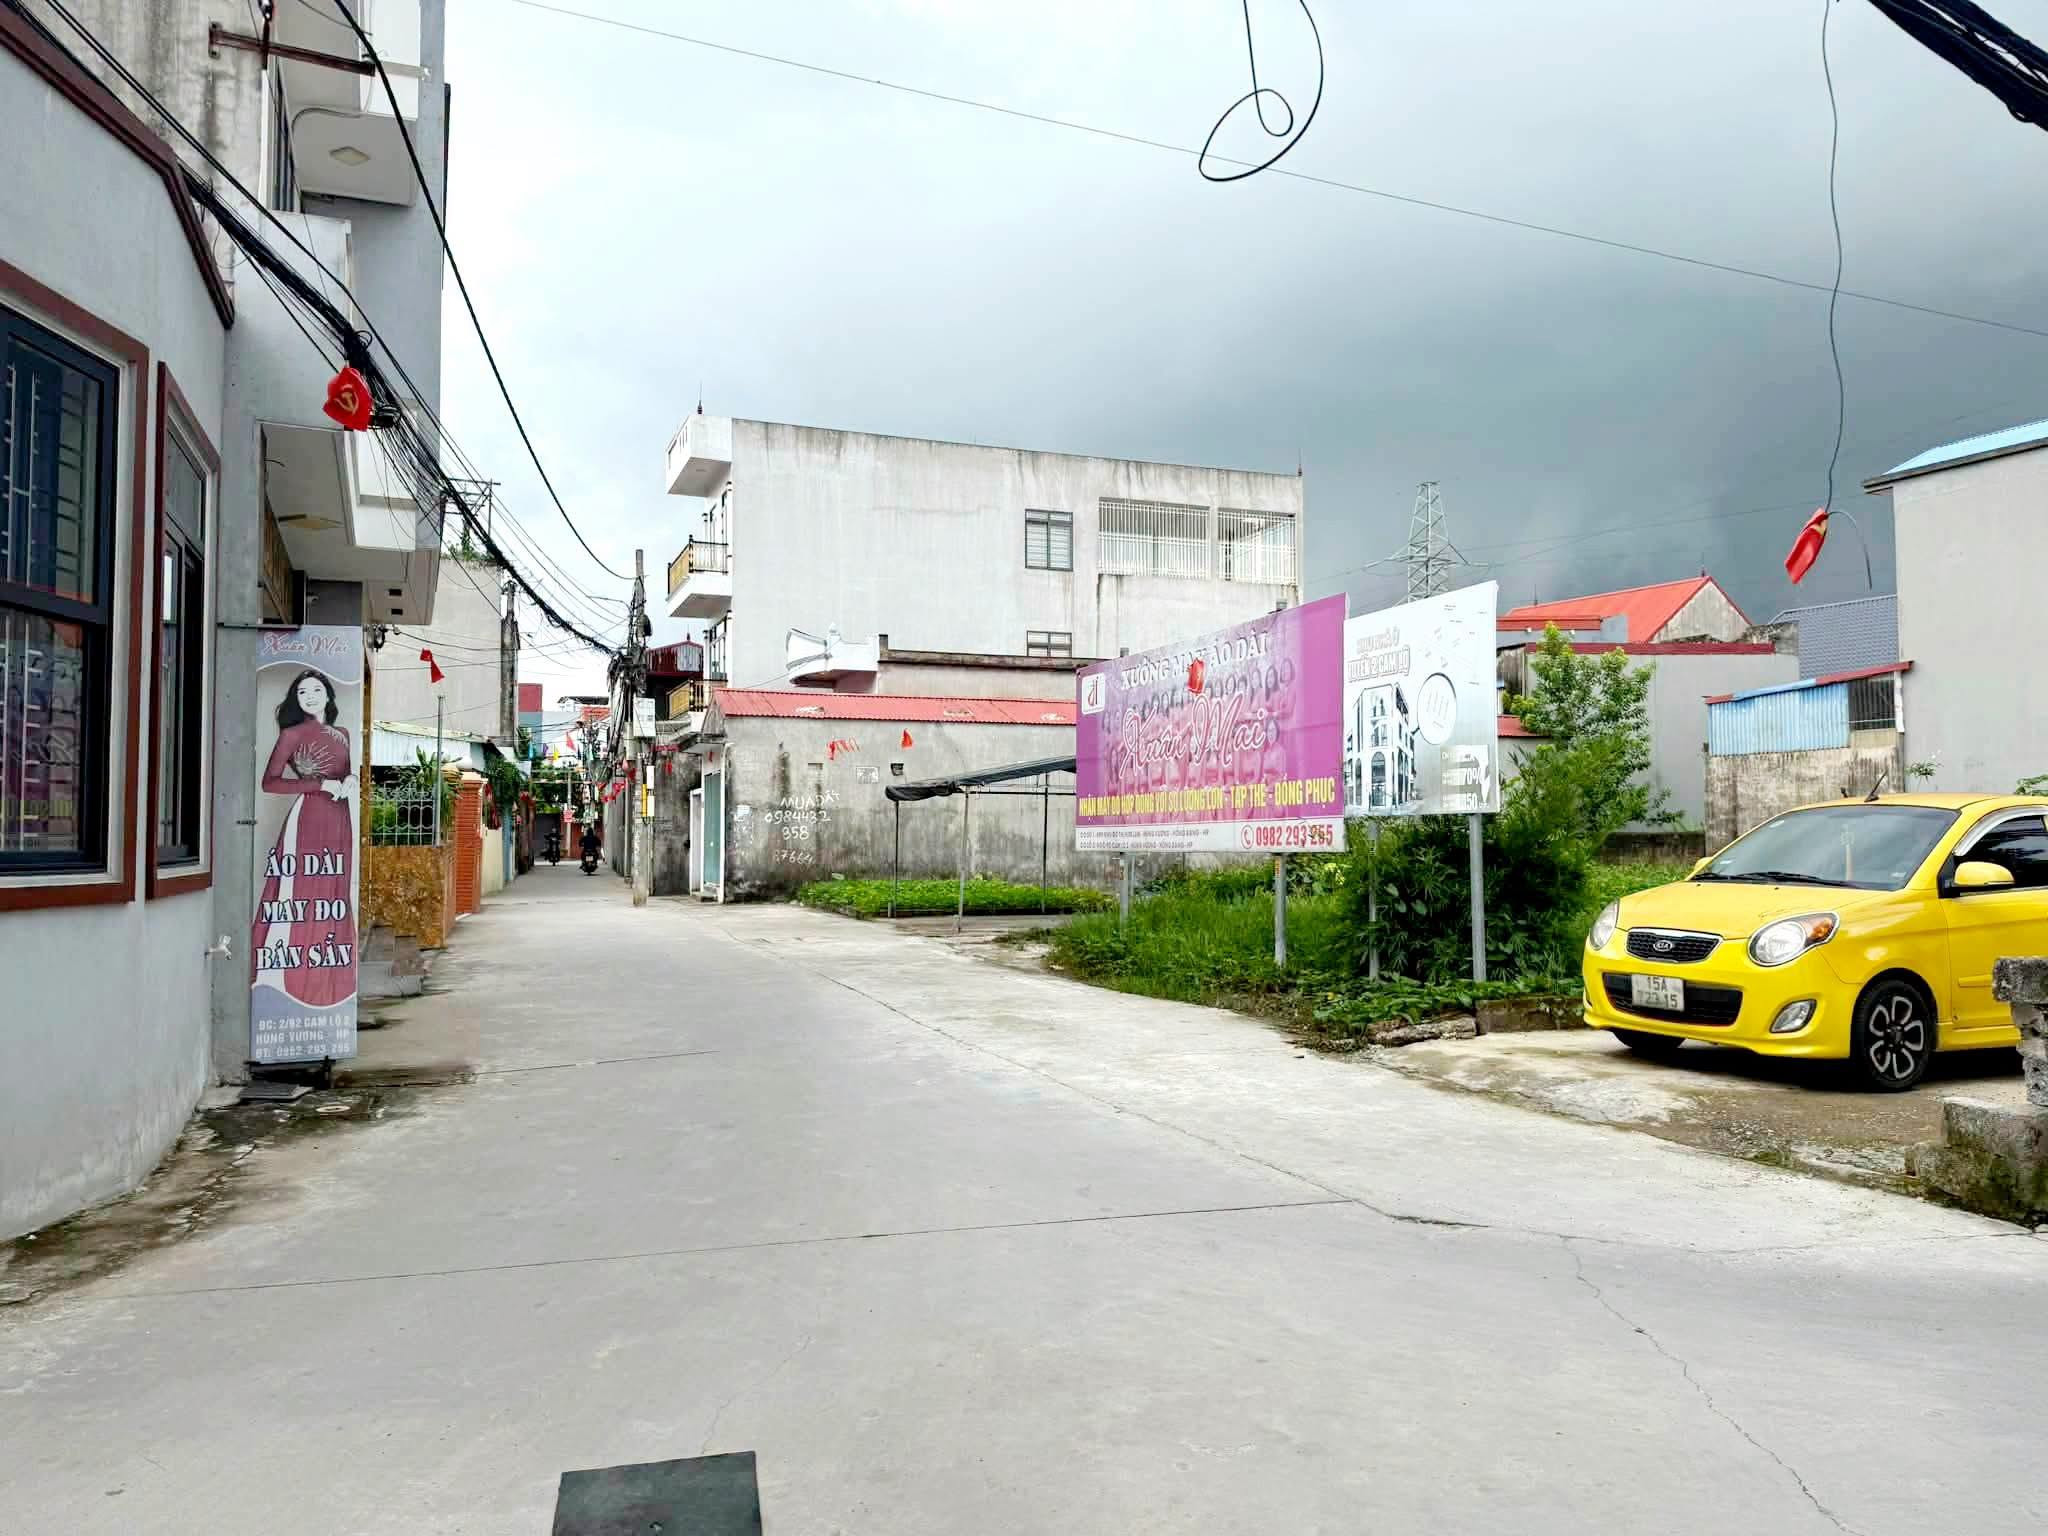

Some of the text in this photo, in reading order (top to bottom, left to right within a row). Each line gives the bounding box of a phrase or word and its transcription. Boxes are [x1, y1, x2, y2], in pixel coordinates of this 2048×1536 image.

[1119, 691, 1267, 779] Xuân Mai
[1305, 777, 1335, 808] PHỤC
[1256, 826, 1282, 846] 0982
[264, 847, 345, 877] ÁO DÀI
[260, 899, 309, 923] MAY
[256, 939, 304, 970] BÁN
